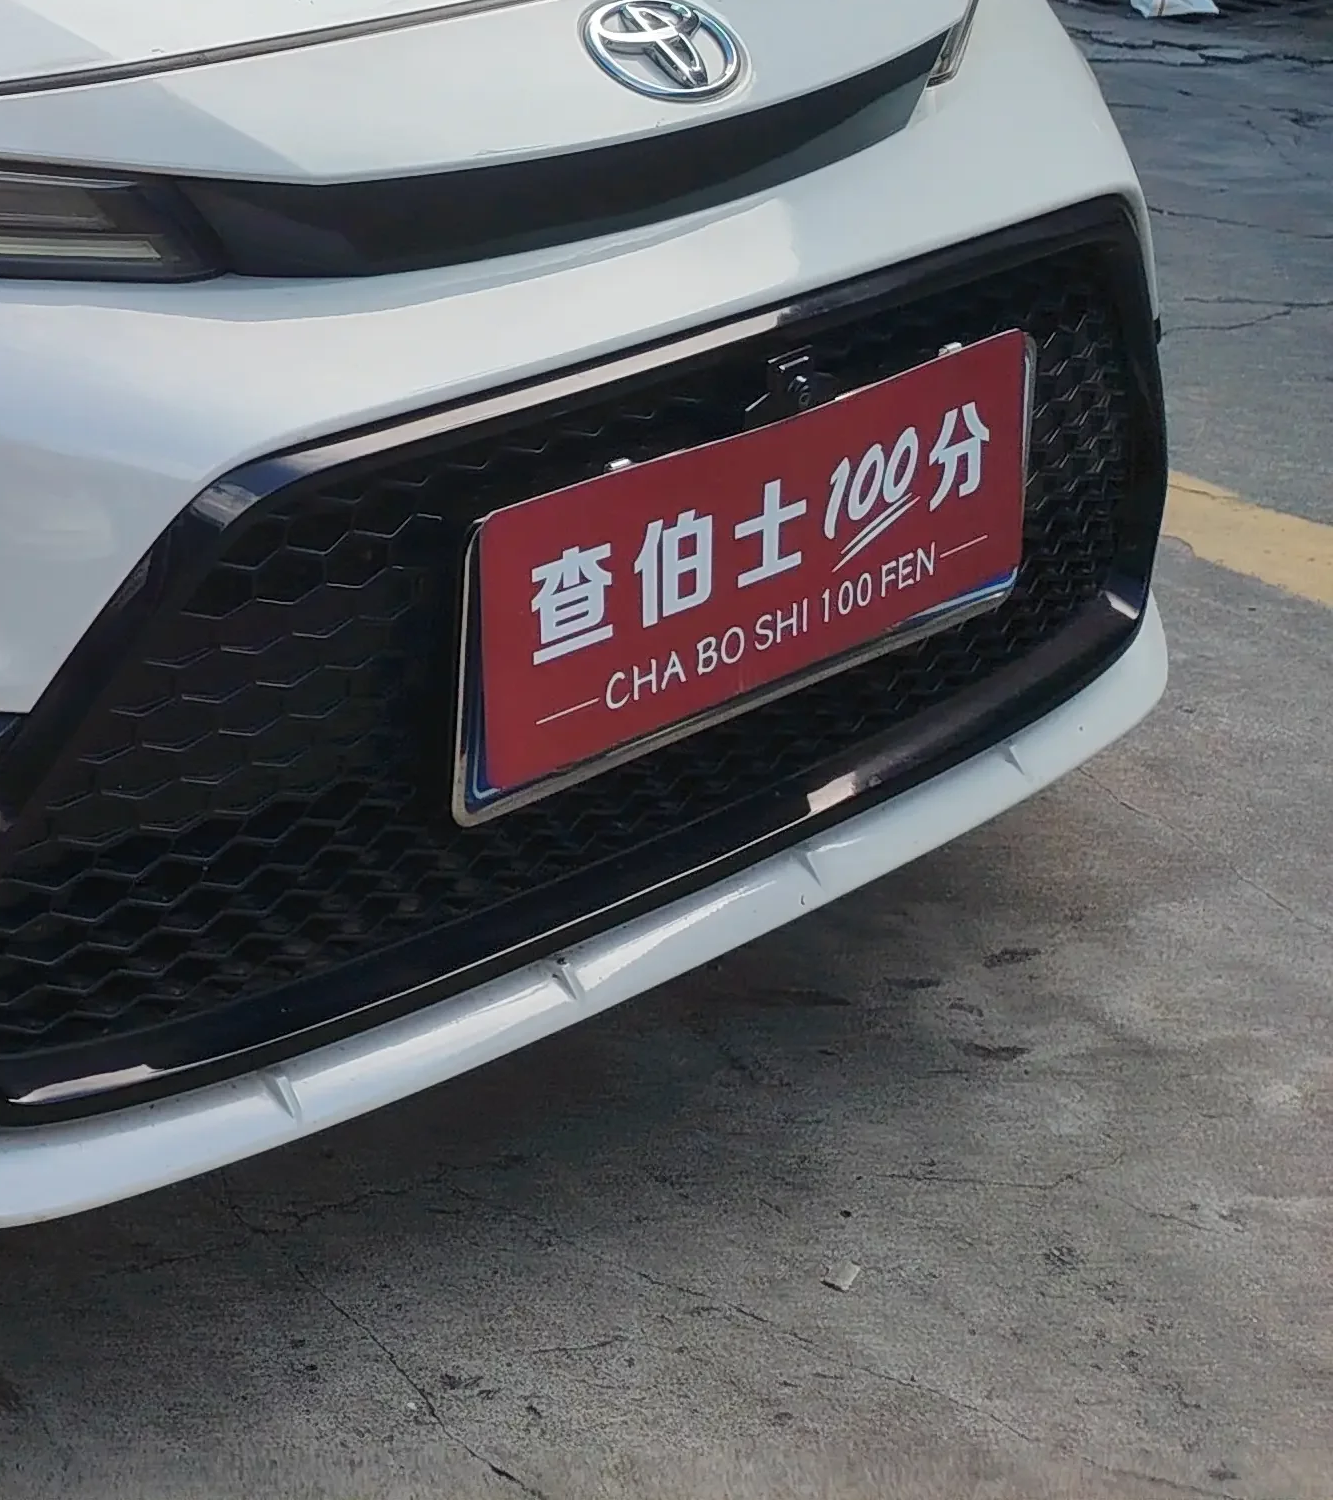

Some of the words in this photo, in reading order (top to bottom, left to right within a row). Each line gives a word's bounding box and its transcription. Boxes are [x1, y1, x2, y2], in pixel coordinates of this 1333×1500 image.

[605, 651, 686, 709] CHA
[697, 628, 744, 675] BO
[755, 600, 809, 652] SHI
[822, 573, 872, 624] 100
[881, 544, 936, 598] FEN
